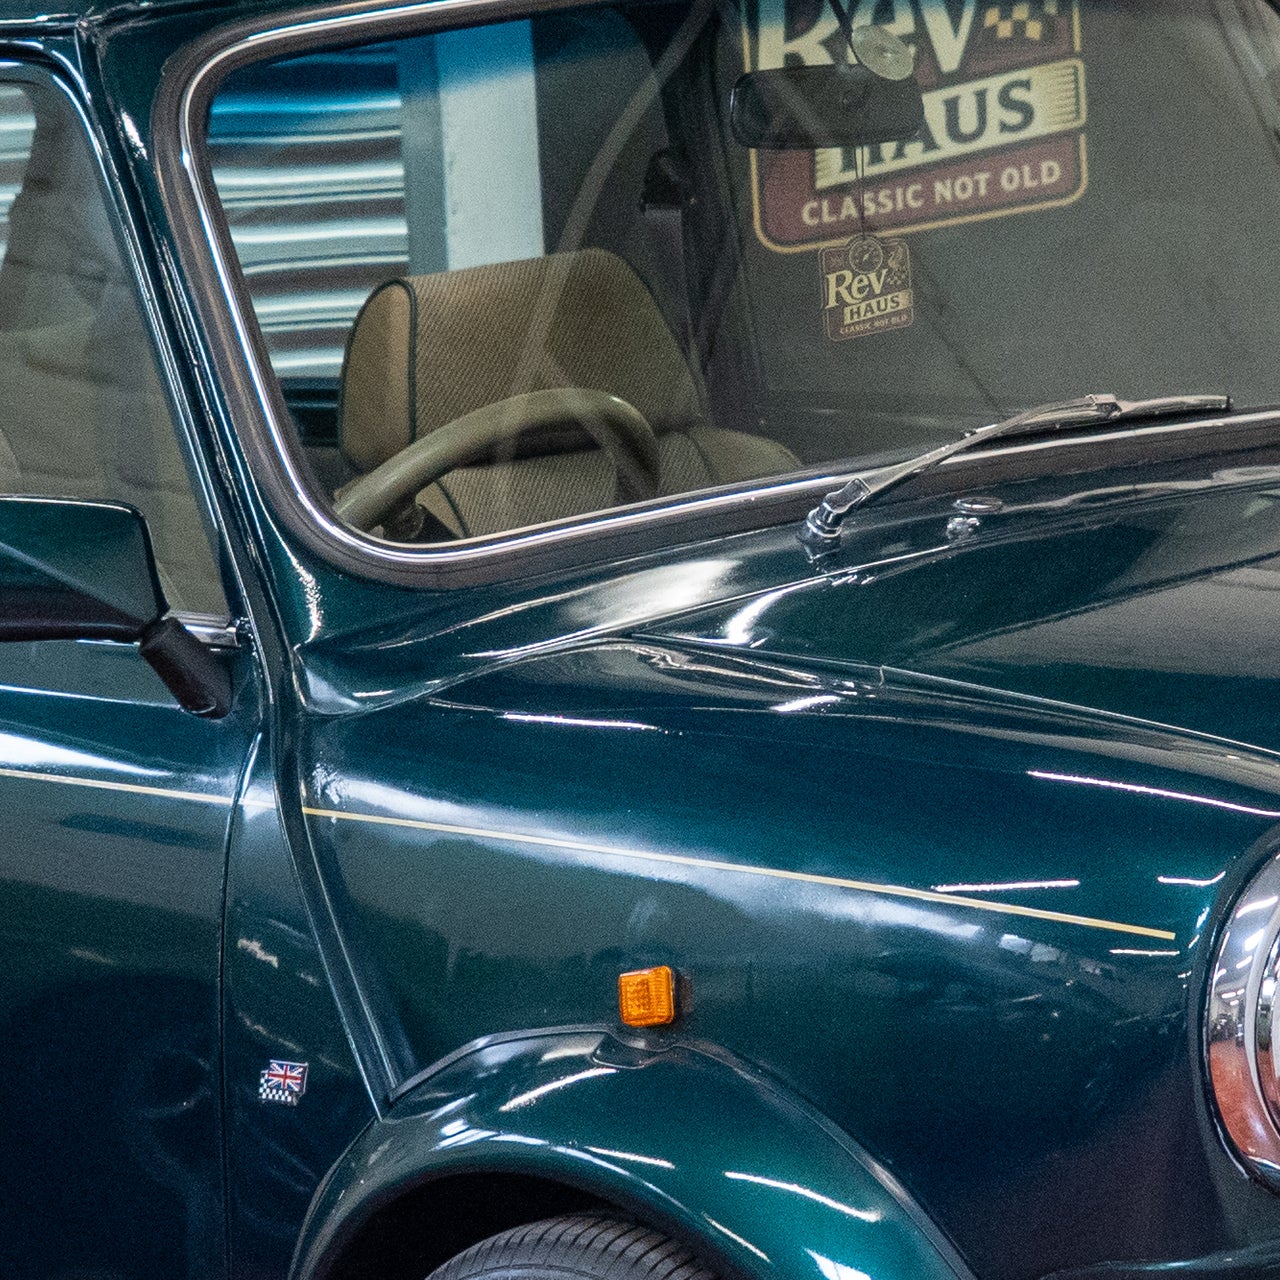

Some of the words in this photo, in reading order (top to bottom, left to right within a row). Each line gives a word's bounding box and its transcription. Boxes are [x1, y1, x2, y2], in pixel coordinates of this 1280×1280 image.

[801, 184, 923, 226] CLASSIC
[934, 172, 990, 204] NOT
[1000, 160, 1061, 191] OLD
[849, 295, 900, 321] HAUS
